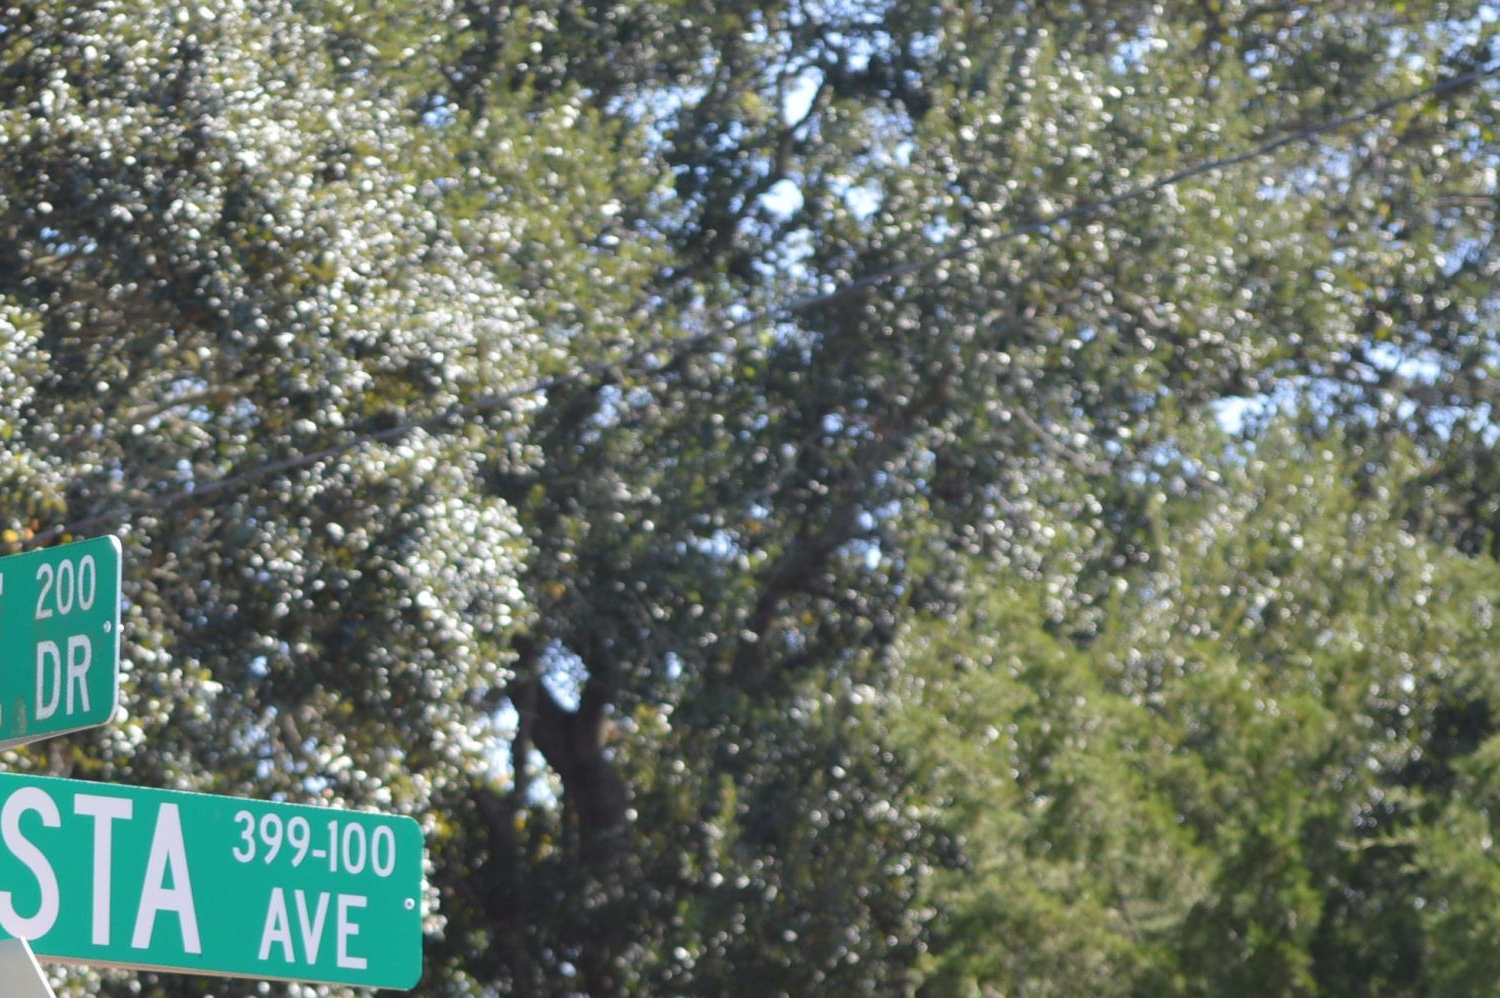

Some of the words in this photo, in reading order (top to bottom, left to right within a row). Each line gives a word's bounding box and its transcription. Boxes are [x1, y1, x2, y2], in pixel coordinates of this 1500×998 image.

[35, 554, 97, 621] 200
[35, 634, 93, 721] DR
[232, 810, 396, 878] 399-100
[258, 887, 368, 970] AVE
